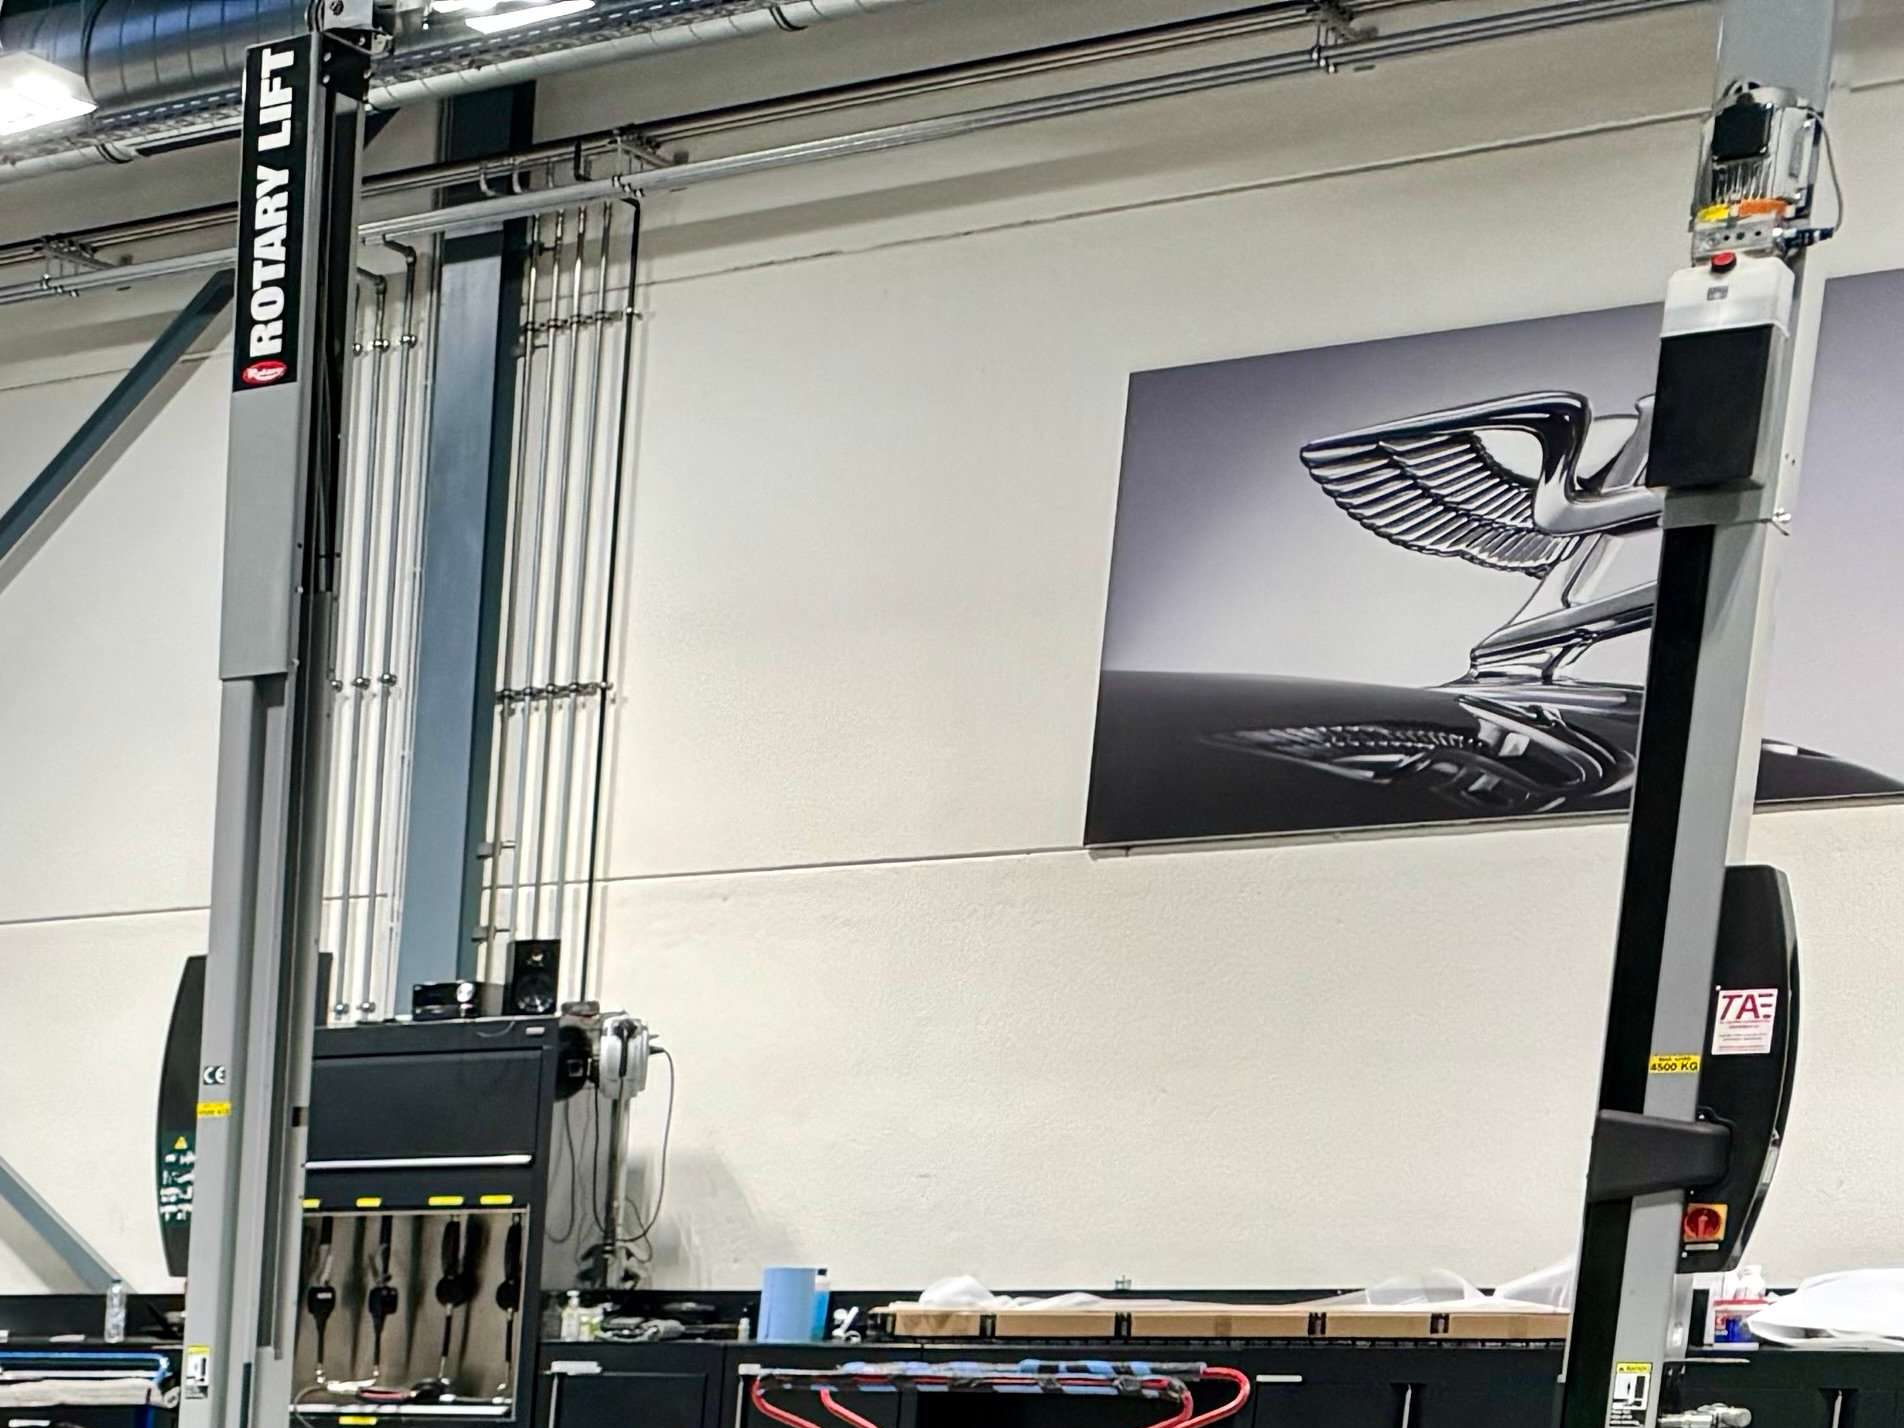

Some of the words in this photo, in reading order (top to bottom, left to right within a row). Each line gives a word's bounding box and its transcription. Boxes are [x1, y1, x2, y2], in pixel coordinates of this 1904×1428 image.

[257, 48, 295, 152] LIFT
[249, 165, 290, 358] ROTARY
[1720, 993, 1774, 1021] TAE
